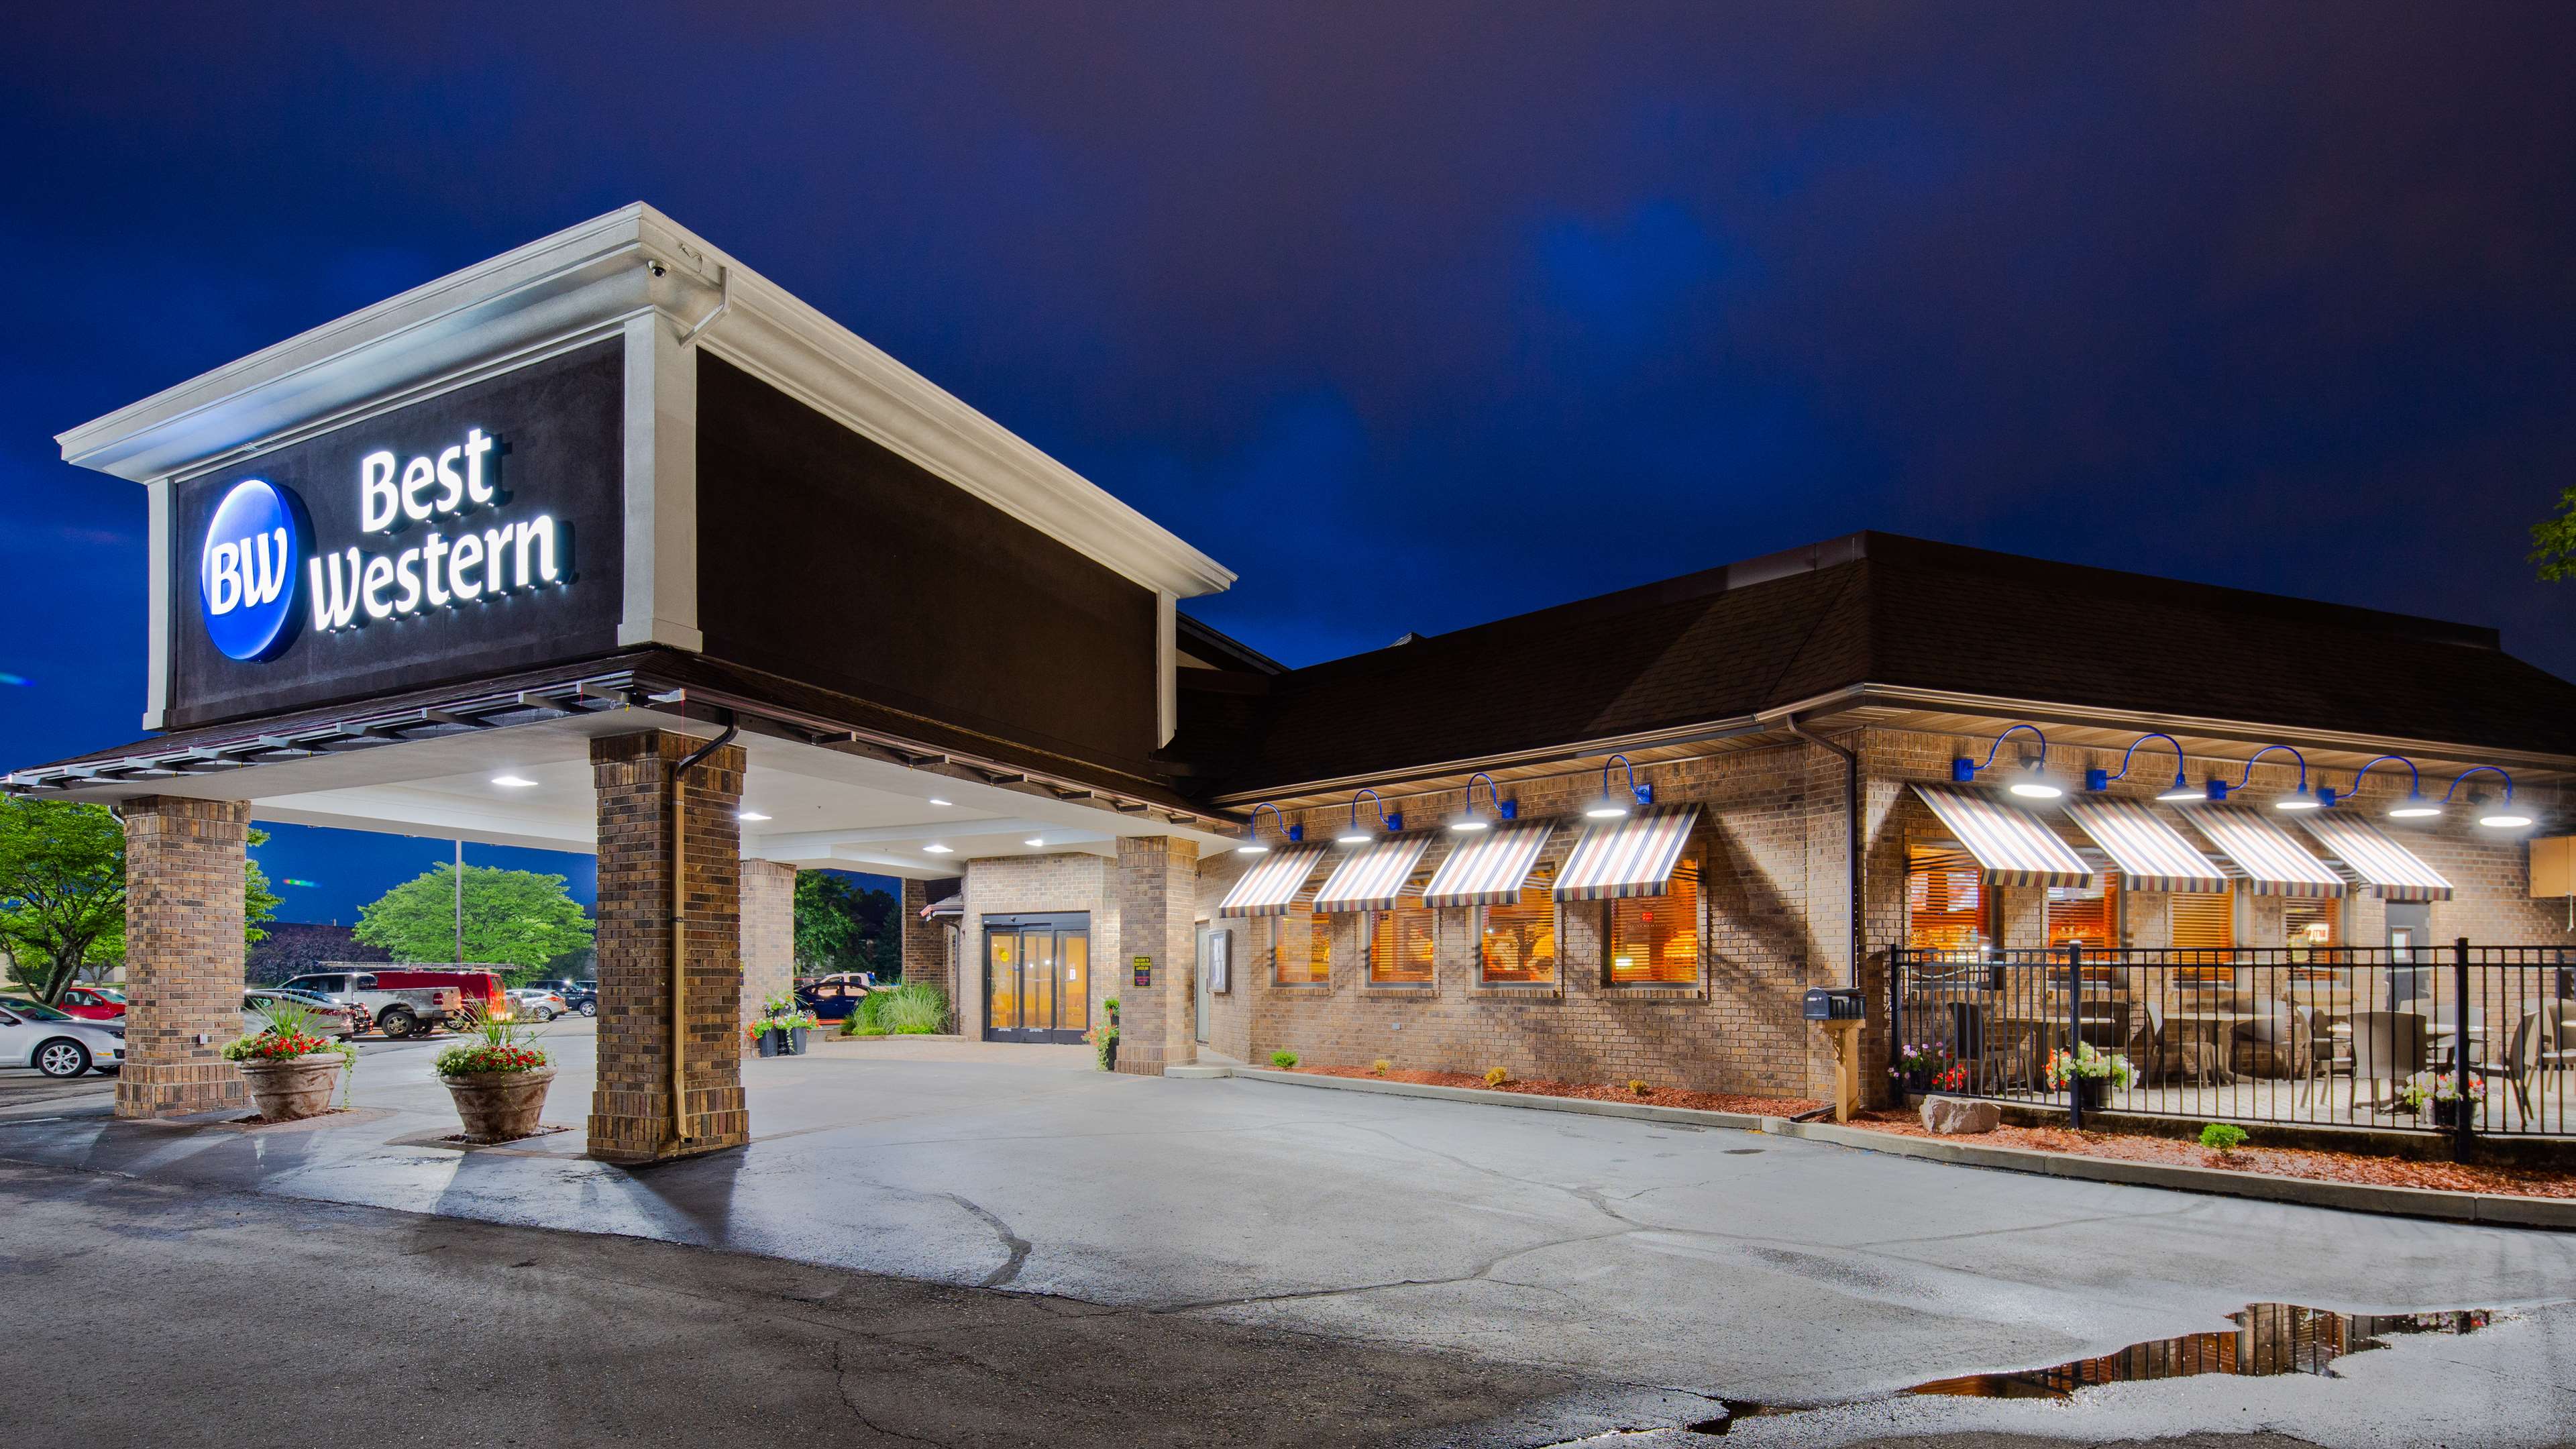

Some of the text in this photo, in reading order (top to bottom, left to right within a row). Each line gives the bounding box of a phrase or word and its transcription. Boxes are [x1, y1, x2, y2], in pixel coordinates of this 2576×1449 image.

[362, 428, 493, 533] Best
[209, 526, 288, 616] BW
[309, 514, 558, 632] Western
